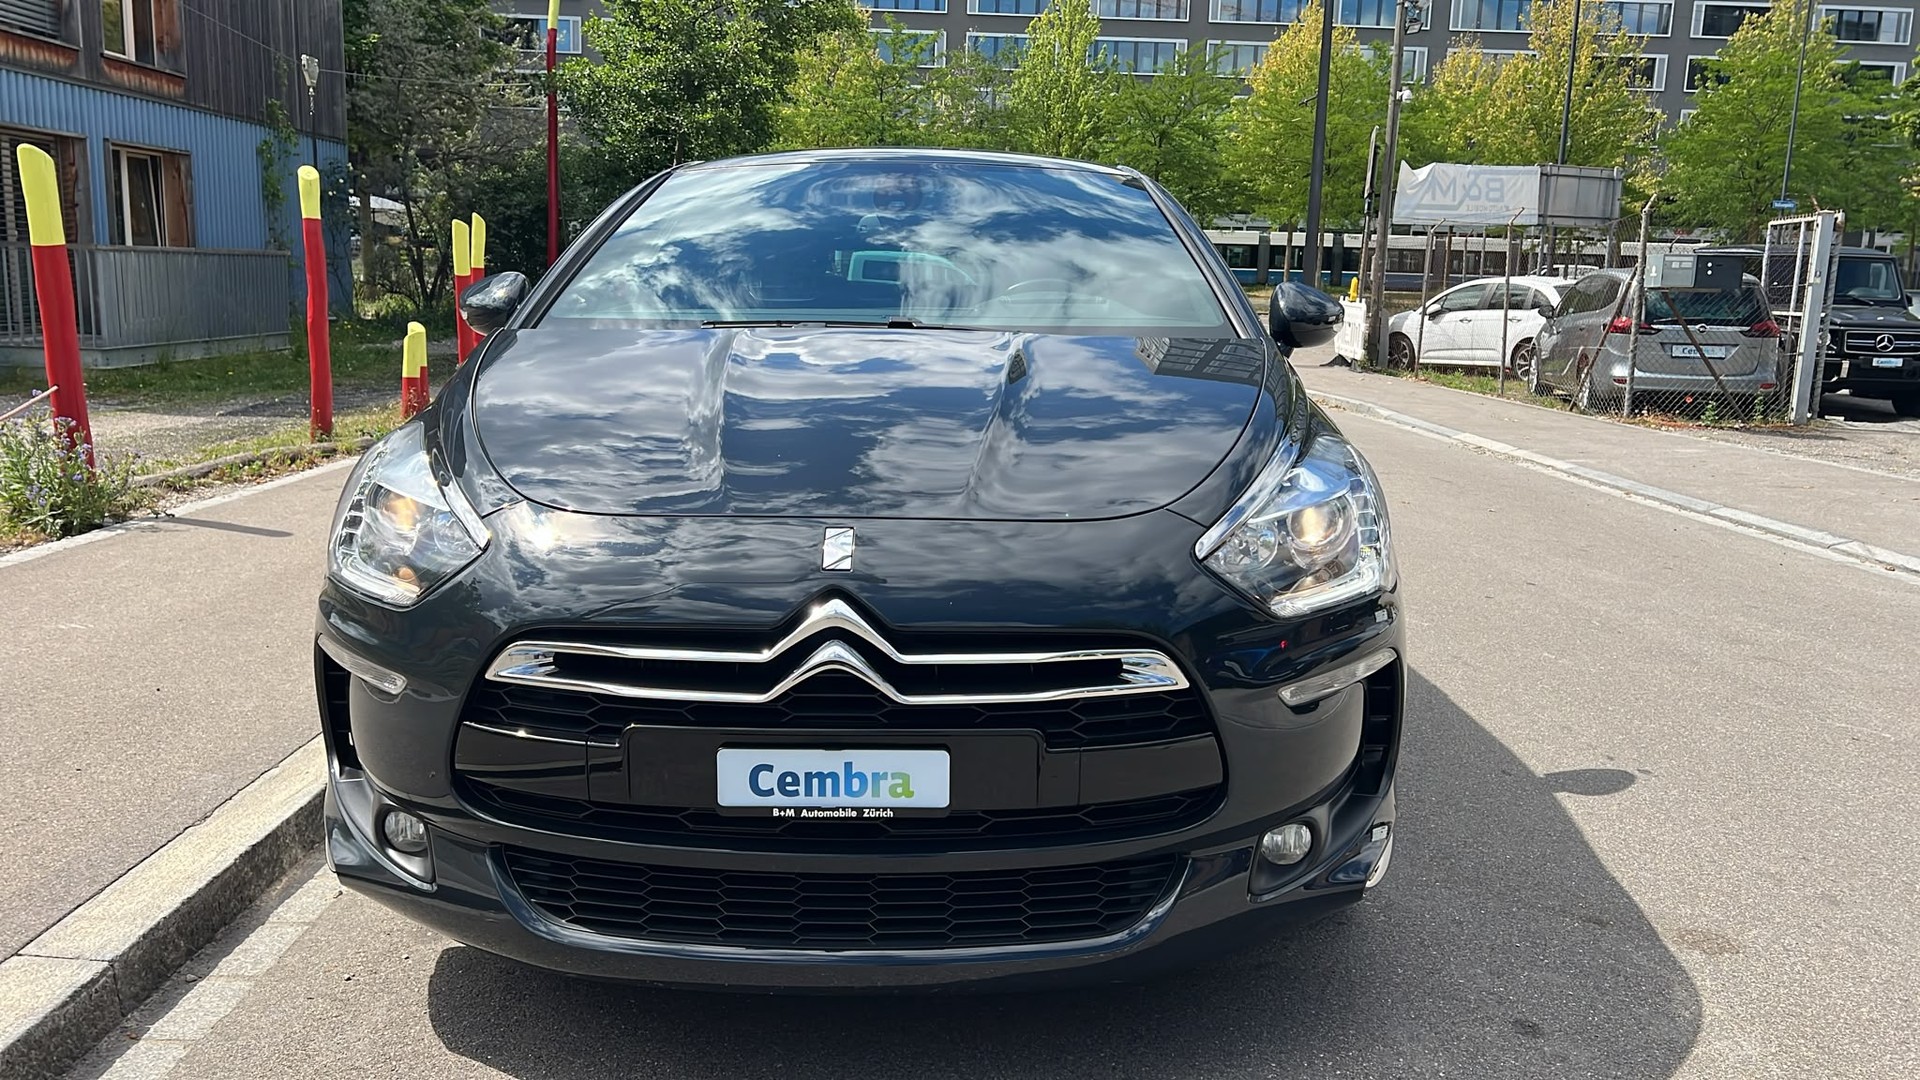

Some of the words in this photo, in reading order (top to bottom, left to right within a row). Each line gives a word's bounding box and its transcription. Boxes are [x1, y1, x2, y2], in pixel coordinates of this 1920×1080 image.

[748, 761, 915, 798] Cembra
[772, 808, 795, 817] B+M
[801, 808, 857, 817] Automobile
[863, 808, 893, 817] Zürich
